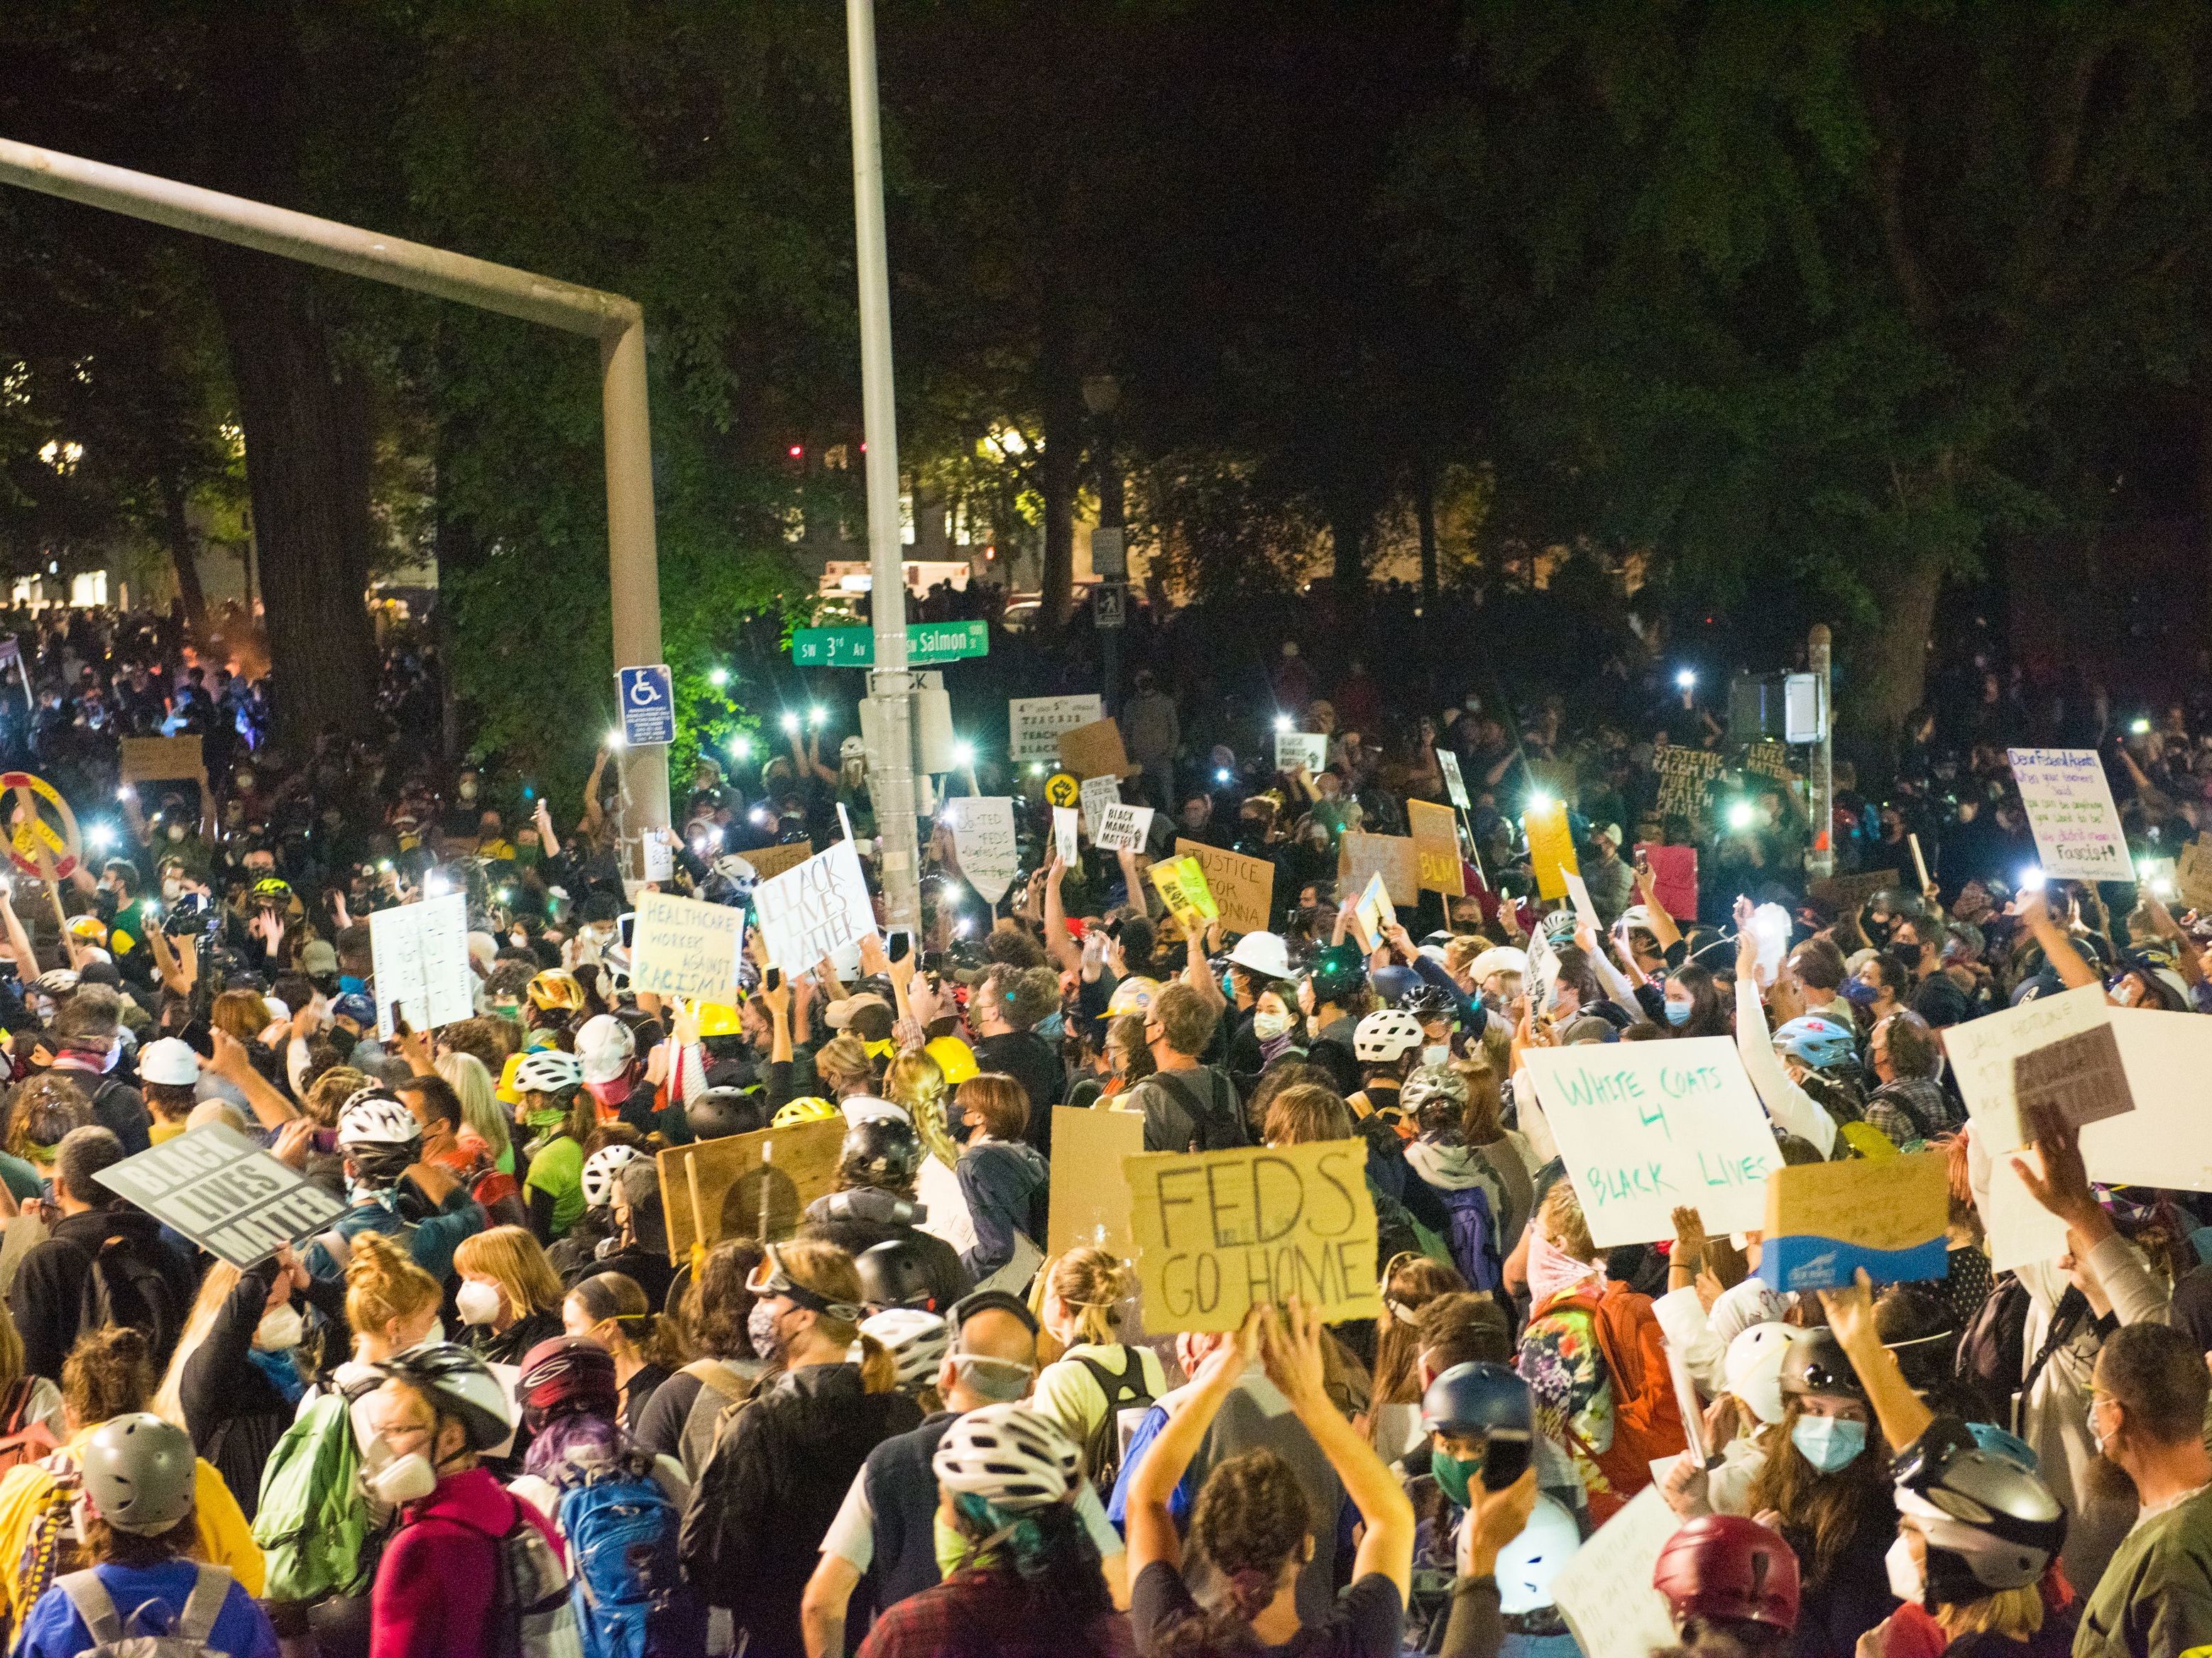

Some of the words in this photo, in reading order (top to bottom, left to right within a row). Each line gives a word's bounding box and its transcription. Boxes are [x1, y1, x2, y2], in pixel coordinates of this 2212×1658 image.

[801, 643, 816, 658] SW
[826, 636, 844, 657] 3rd
[853, 642, 865, 657] Av
[919, 630, 966, 652] Salmon
[1655, 746, 1724, 767] SYSTEMIC
[1751, 744, 1784, 764] LIVES
[2008, 750, 2035, 766] Dear
[2035, 750, 2069, 767] Federal
[1658, 789, 1714, 808] HEALTH
[1662, 774, 1707, 792] PUBLIC
[1107, 808, 1135, 822] BLACK
[1188, 847, 1261, 884] JUSTICE
[1419, 852, 1457, 886] BLM
[761, 852, 846, 924] BLACK
[1207, 877, 1237, 899] FOR
[646, 899, 736, 933] HEALTHCARE
[782, 883, 848, 938] LIVES
[1215, 897, 1260, 926] ONNA
[777, 910, 863, 970] MATTER
[637, 961, 726, 998] RACISM!
[681, 950, 731, 977] AGAINST
[1553, 1067, 1646, 1106] WHITE
[1660, 1066, 1723, 1099] COATS
[1638, 1102, 1672, 1143] 4
[117, 1130, 245, 1197] BLACK
[1587, 1161, 1680, 1207] BLACK
[1697, 1151, 1768, 1188] LIVES
[175, 1164, 281, 1224] LIVES
[1156, 1151, 1357, 1248] FEDS
[207, 1185, 348, 1264] MATTER
[1161, 1251, 1221, 1318] GO
[1245, 1239, 1374, 1311] HOME
